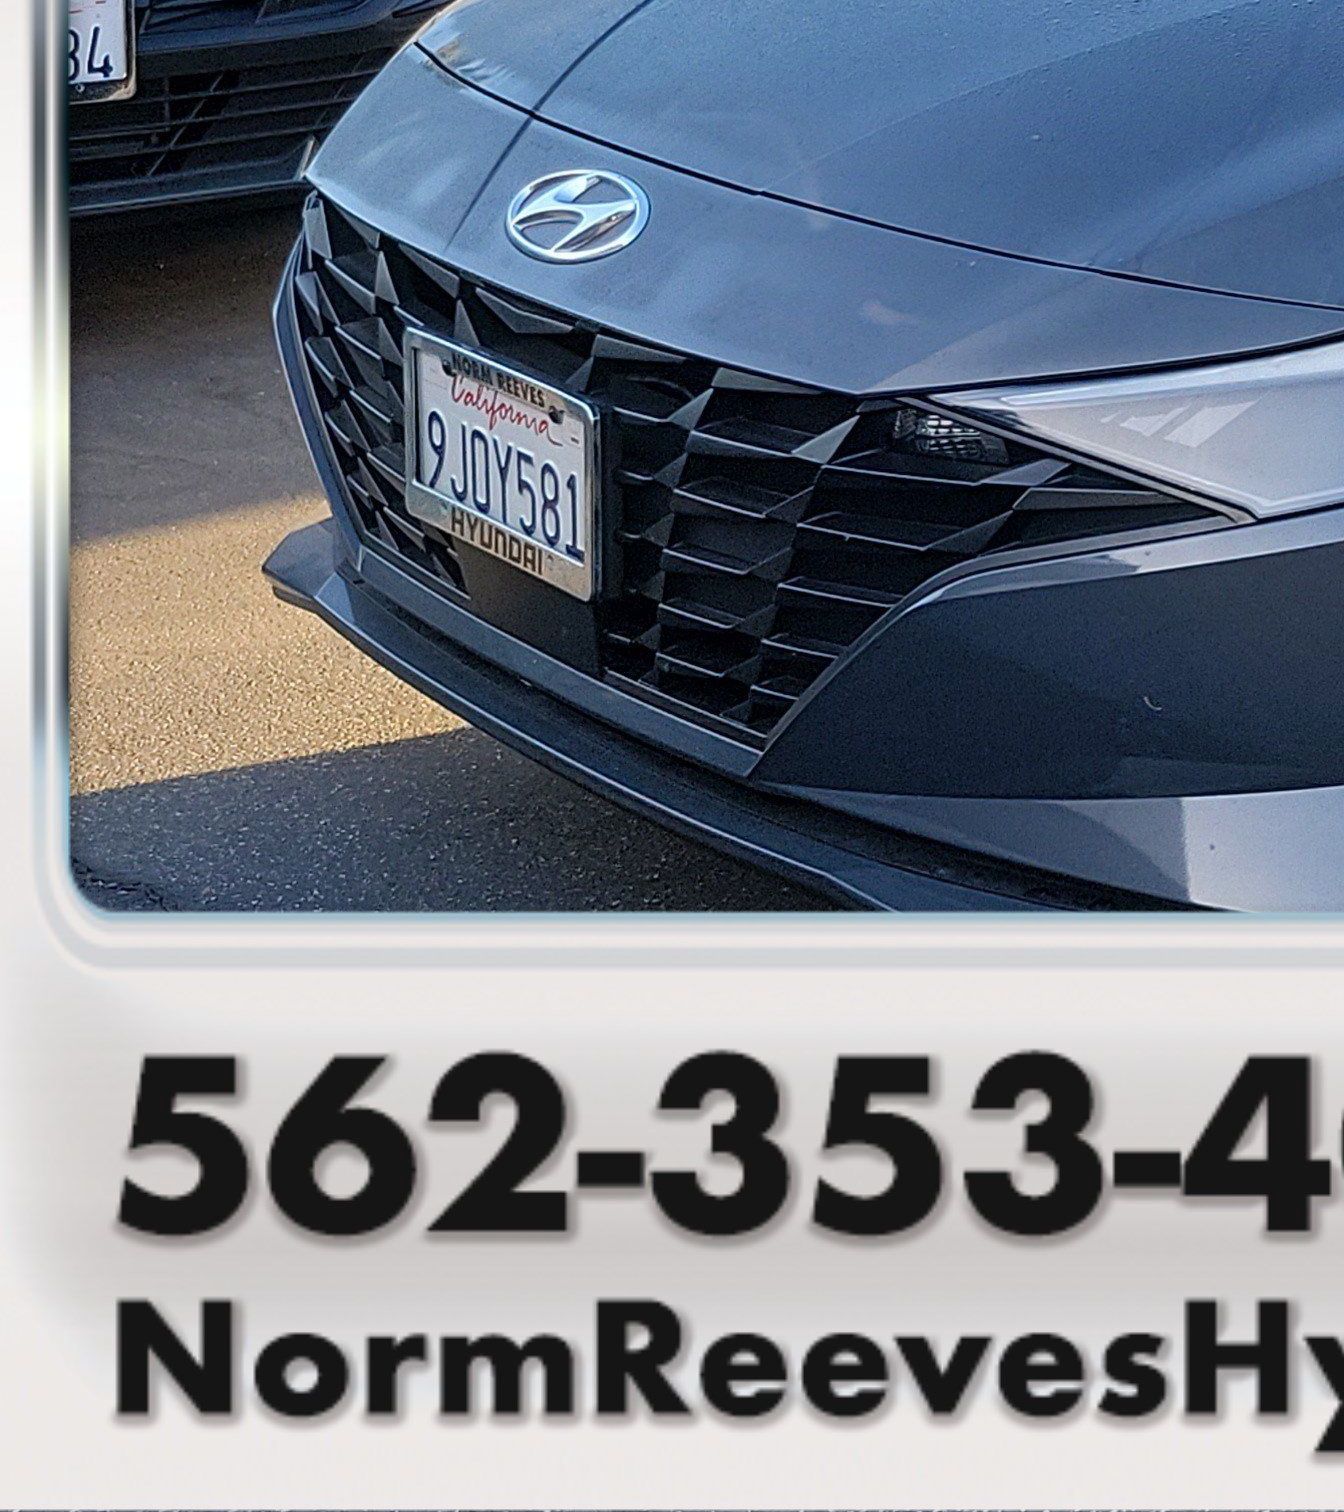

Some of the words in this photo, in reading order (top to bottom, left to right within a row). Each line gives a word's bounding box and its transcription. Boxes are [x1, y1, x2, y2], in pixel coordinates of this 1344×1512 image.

[451, 352, 493, 387] NORM
[496, 371, 546, 408] REEVES
[451, 374, 563, 446] California
[451, 507, 544, 576] HYUNDAI
